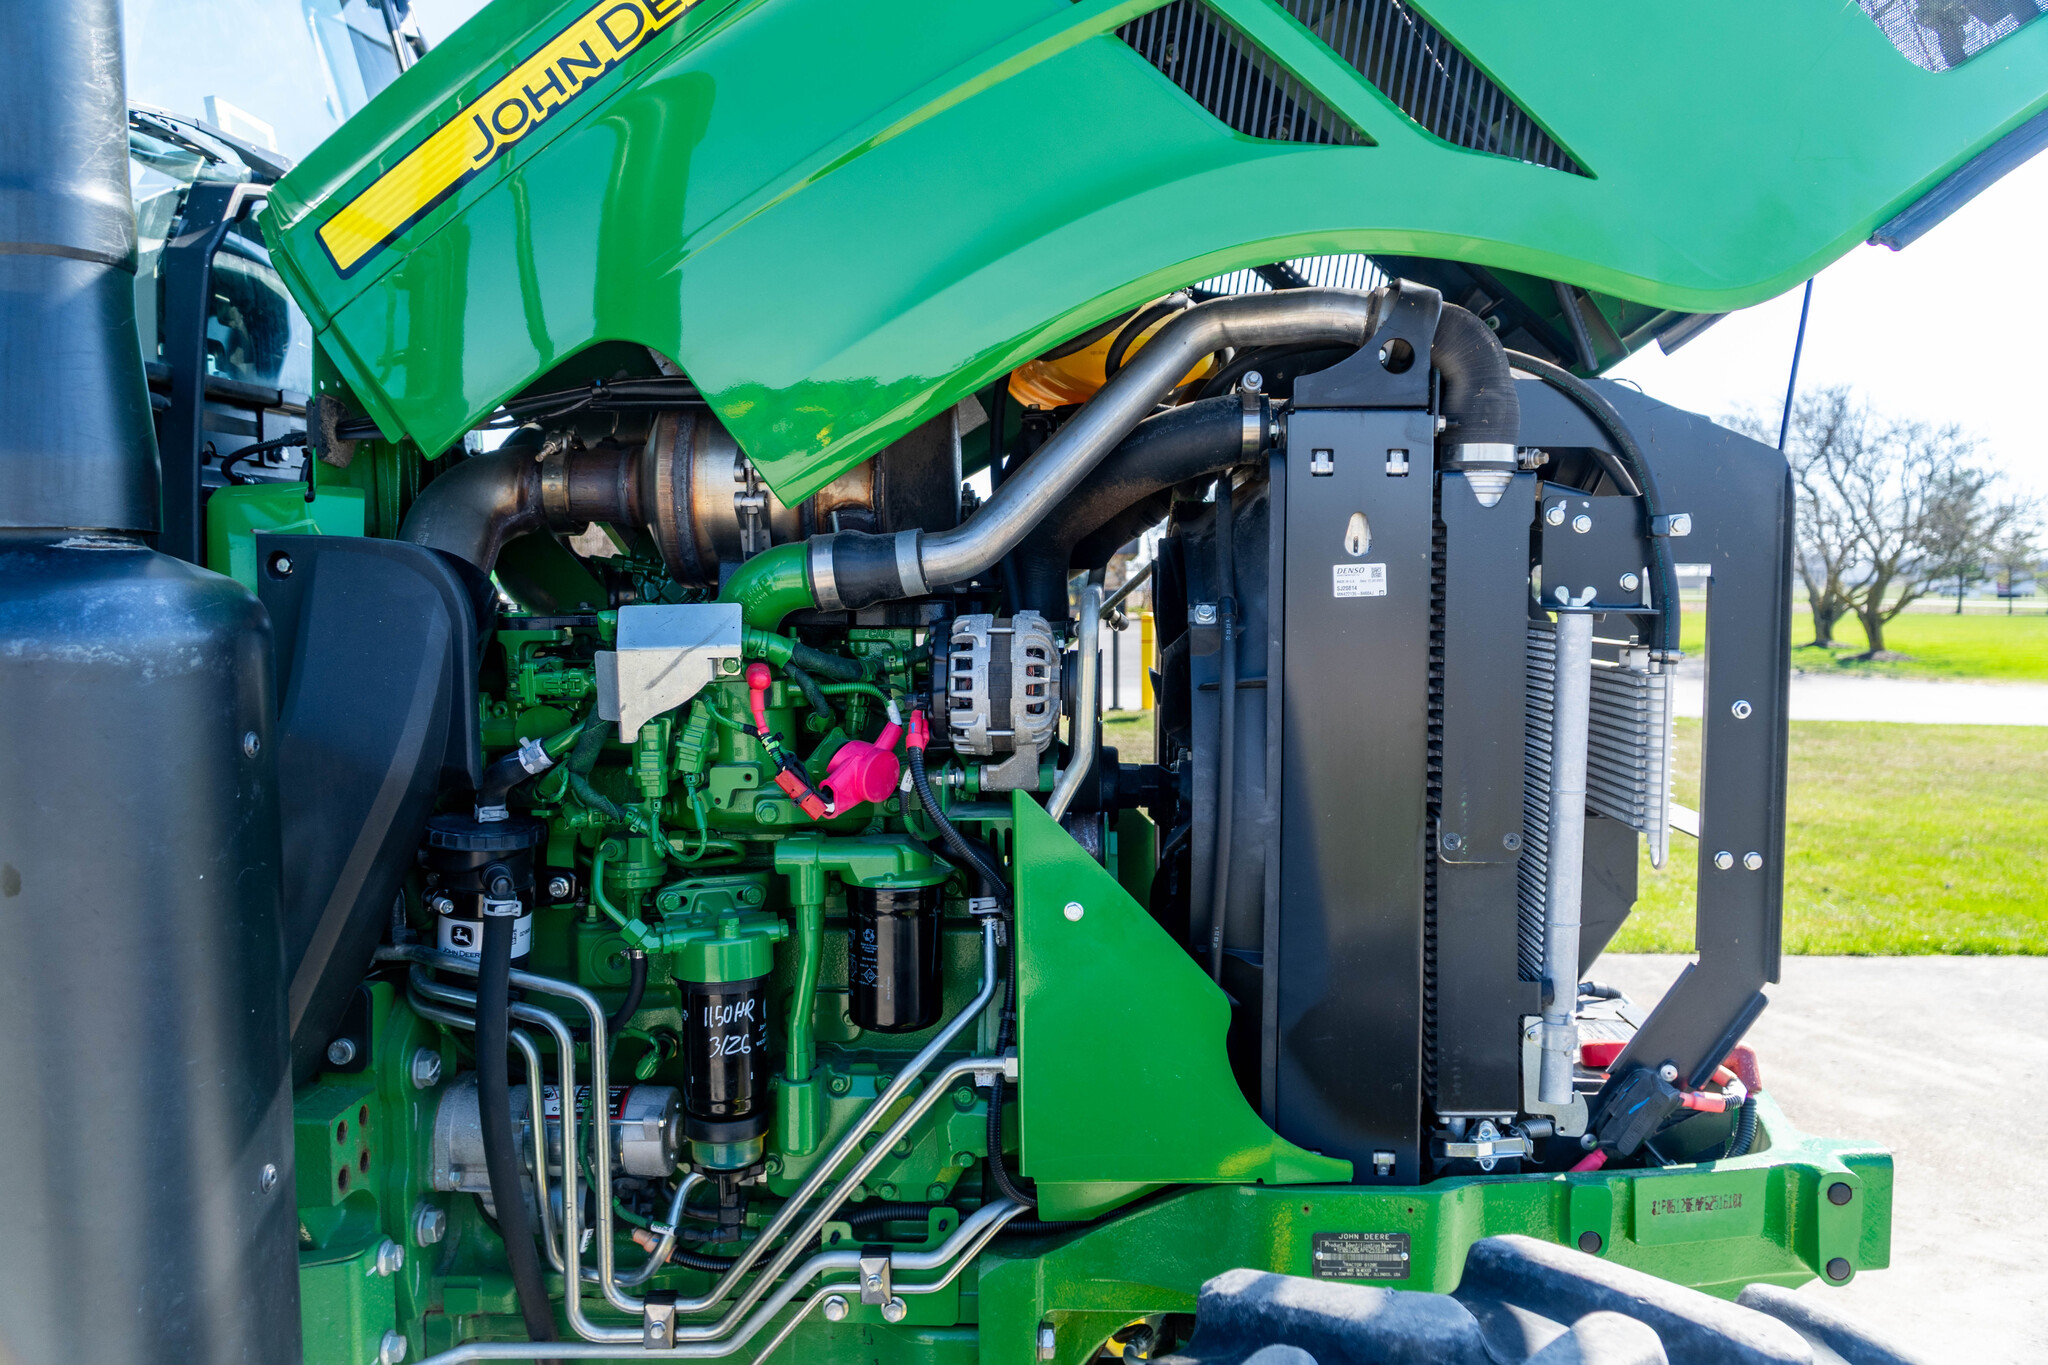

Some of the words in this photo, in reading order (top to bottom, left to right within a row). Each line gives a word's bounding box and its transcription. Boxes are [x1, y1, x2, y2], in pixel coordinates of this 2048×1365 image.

[472, 39, 603, 162] JOHN
[443, 947, 459, 956] JOHN
[460, 950, 481, 958] DEER
